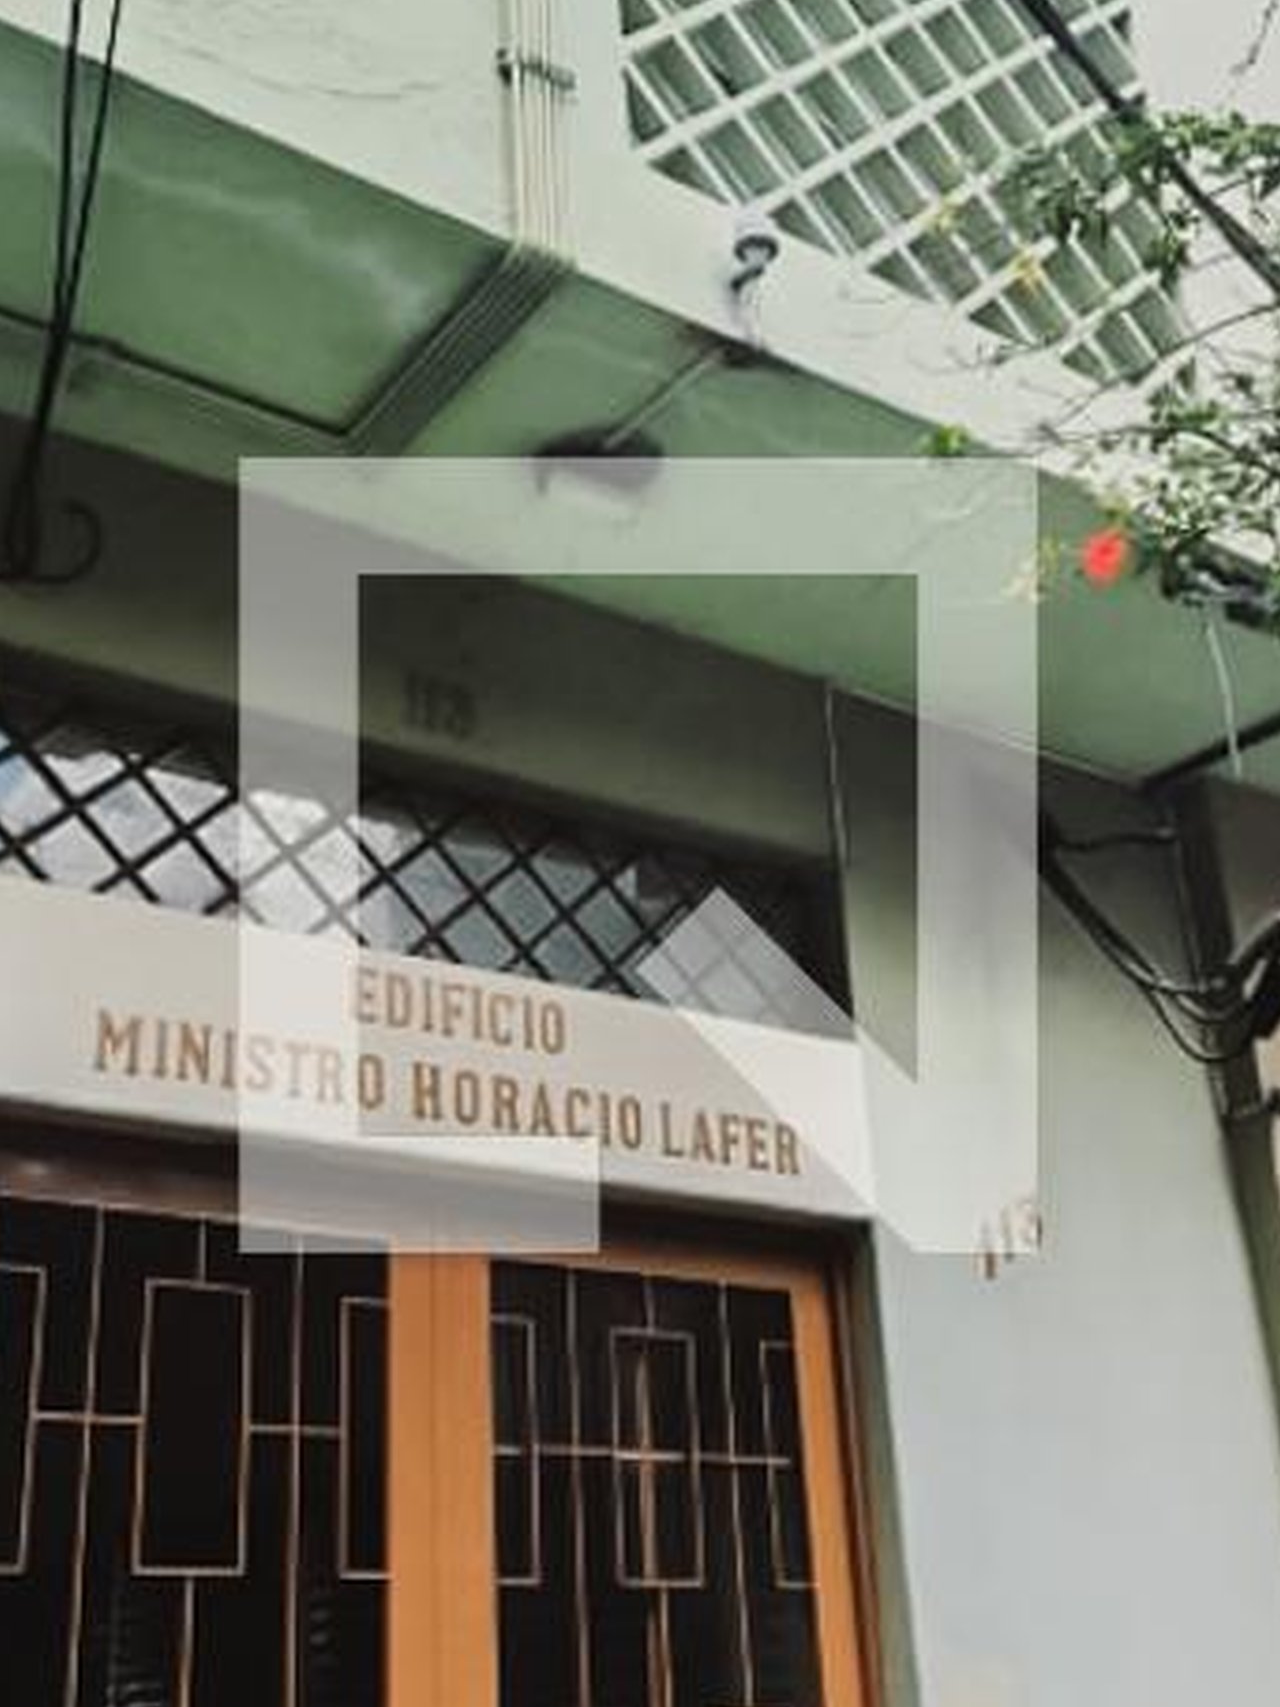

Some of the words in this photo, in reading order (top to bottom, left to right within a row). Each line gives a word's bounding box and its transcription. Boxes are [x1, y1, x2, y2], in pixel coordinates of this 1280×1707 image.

[356, 965, 566, 1055] EDIFICIO
[94, 1008, 385, 1110] MINISTRO
[412, 1060, 643, 1150] HORACIO
[659, 1101, 801, 1176] LAFER
